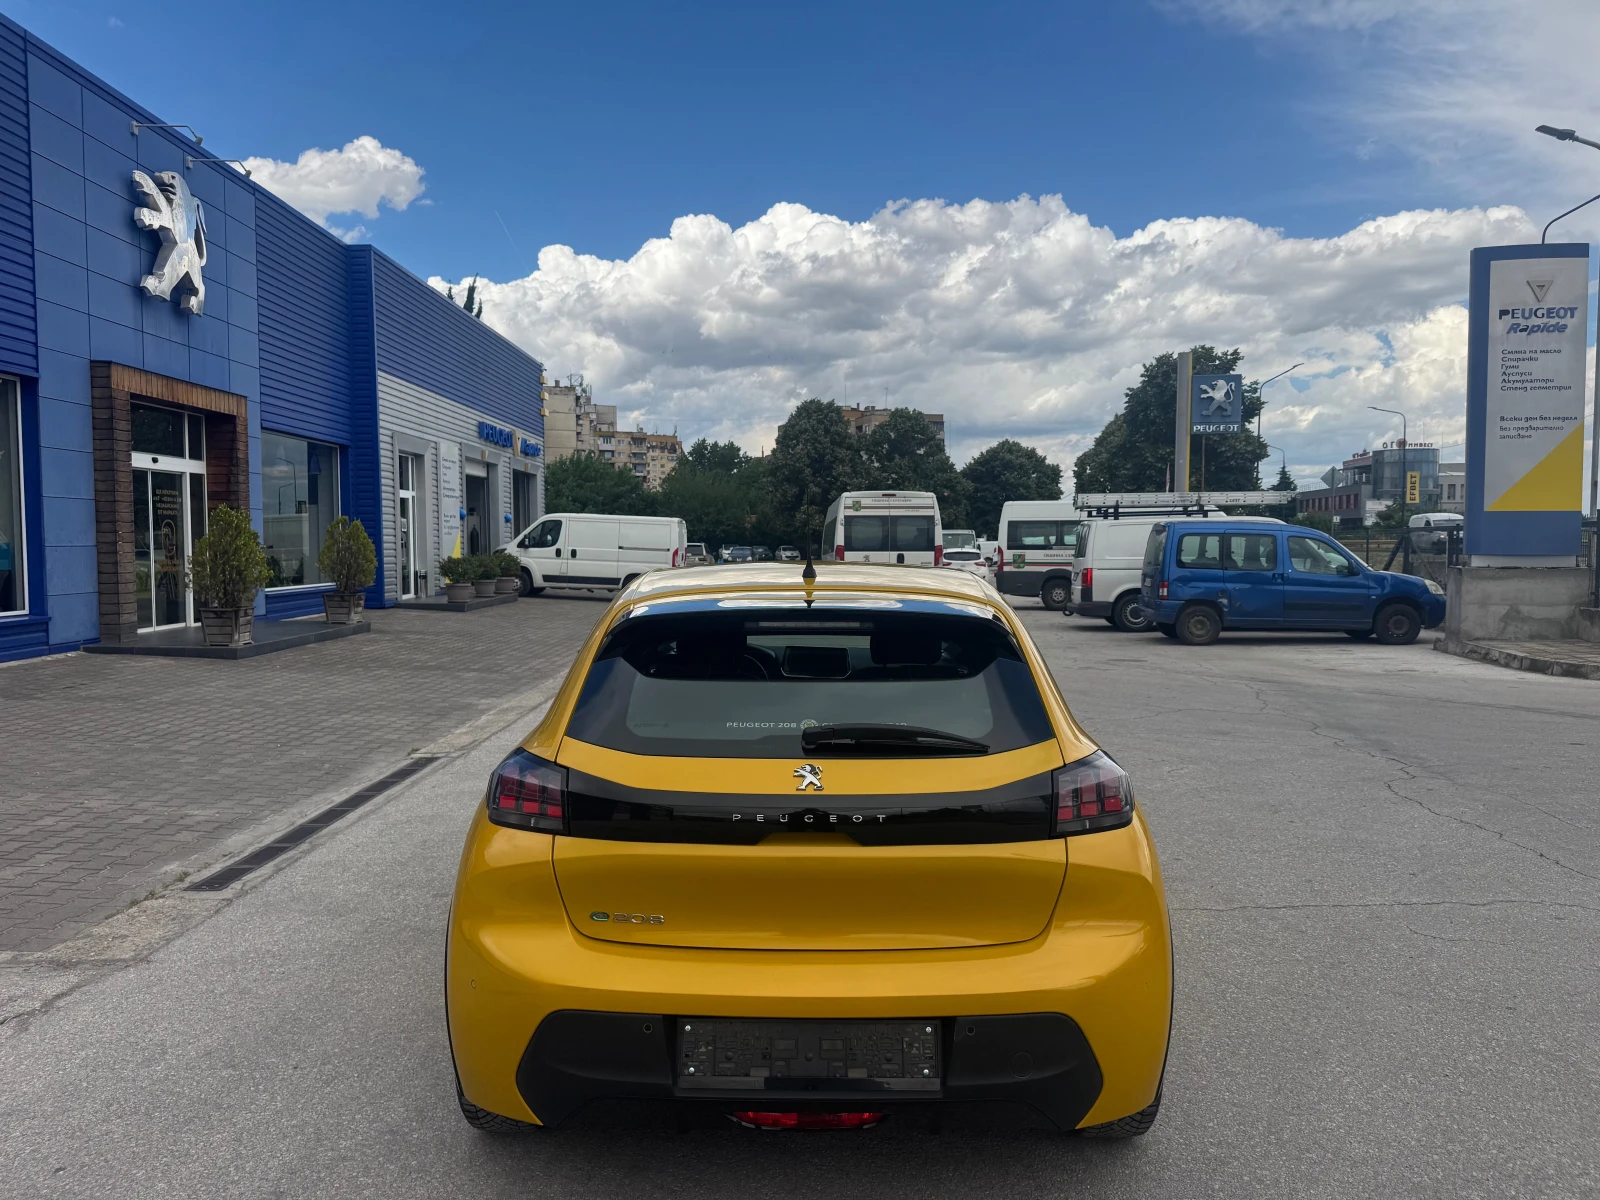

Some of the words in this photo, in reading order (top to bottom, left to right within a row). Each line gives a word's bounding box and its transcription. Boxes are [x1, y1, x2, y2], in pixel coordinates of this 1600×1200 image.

[1498, 307, 1578, 320] PEUGEOT
[1506, 321, 1568, 335] Rapide
[1501, 355, 1539, 363] Спирачки
[1500, 363, 1520, 371] Гуми
[1500, 377, 1555, 385] Акумулатори
[1193, 424, 1239, 433] PEUGEOT
[1409, 474, 1417, 501] EFBET
[732, 814, 886, 823] PEUGEOT
